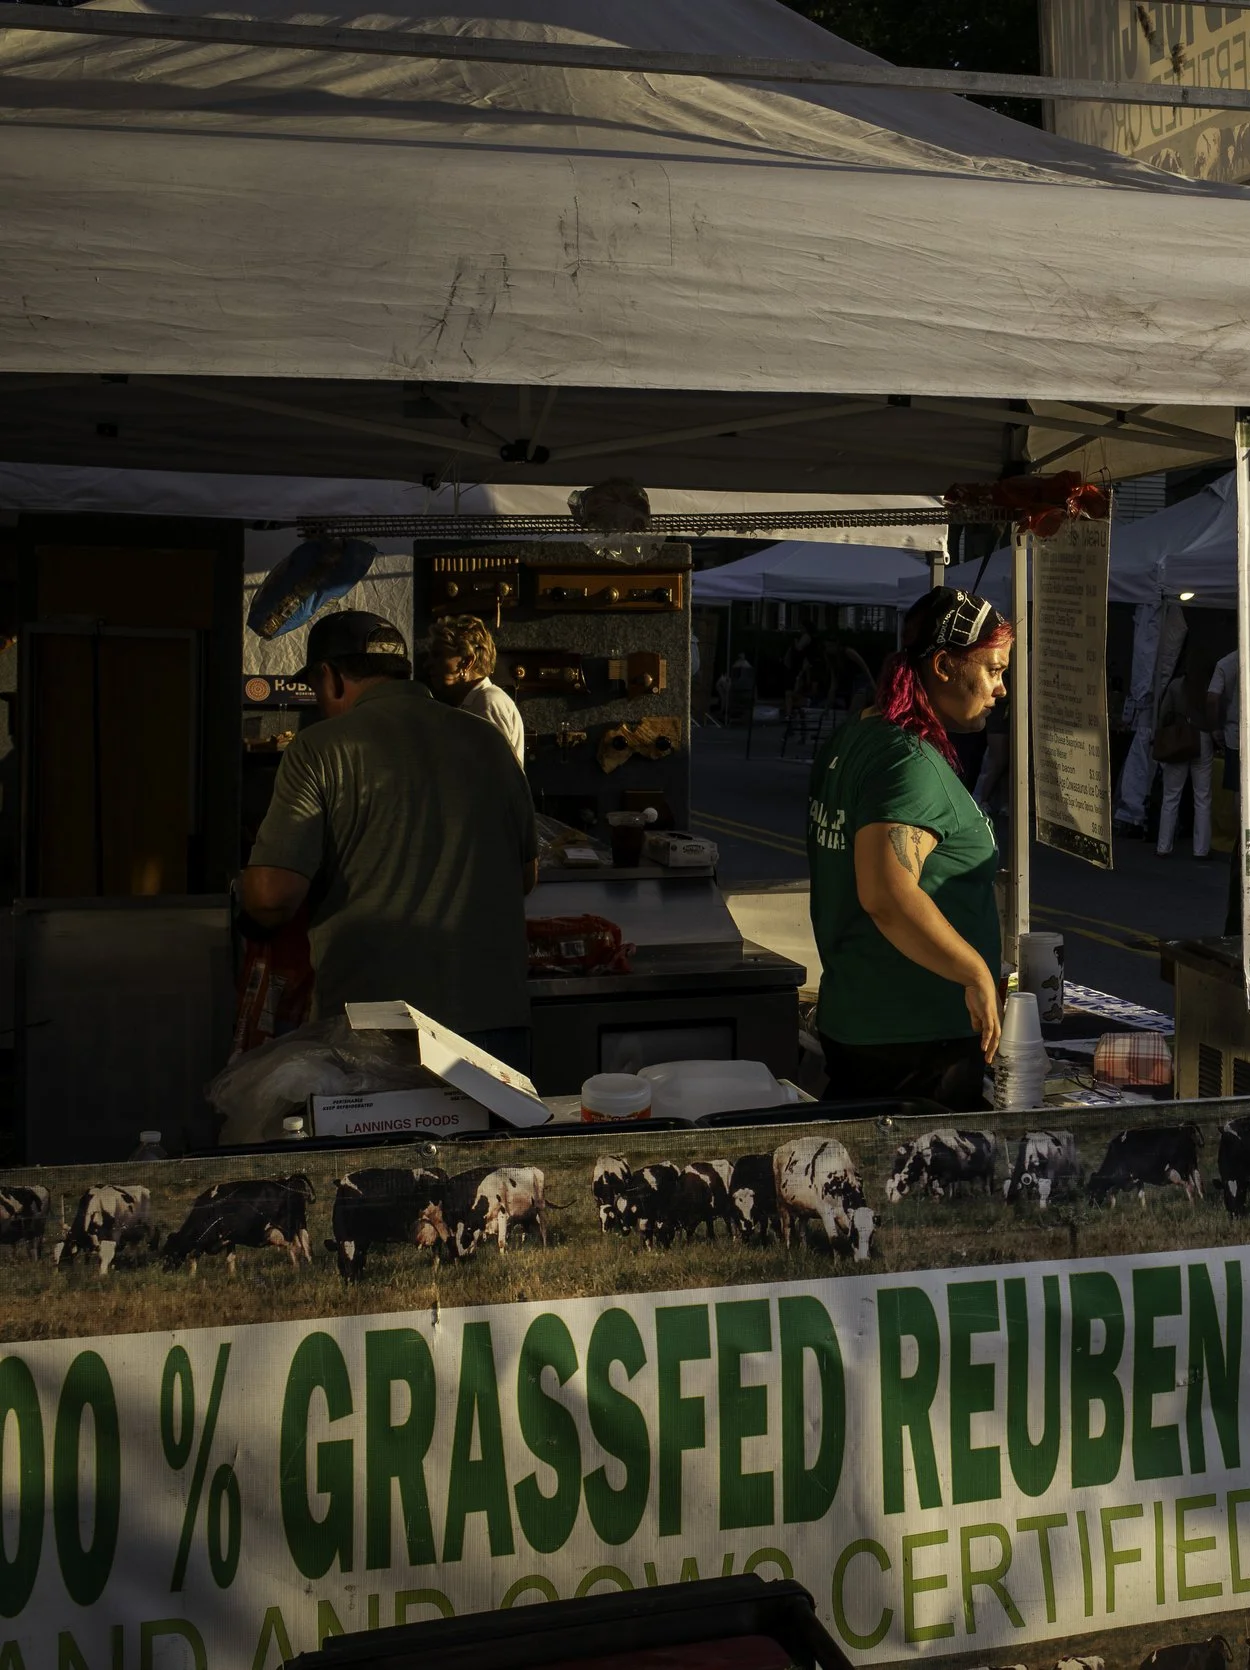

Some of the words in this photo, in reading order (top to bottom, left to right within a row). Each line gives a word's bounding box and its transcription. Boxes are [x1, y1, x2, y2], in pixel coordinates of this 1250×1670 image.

[345, 1119, 411, 1134] LANNINGS
[415, 1115, 459, 1127] FOODS
[160, 1342, 241, 1593] %
[280, 1293, 846, 1579] GRASSFED
[876, 1259, 1243, 1516] REUBEN
